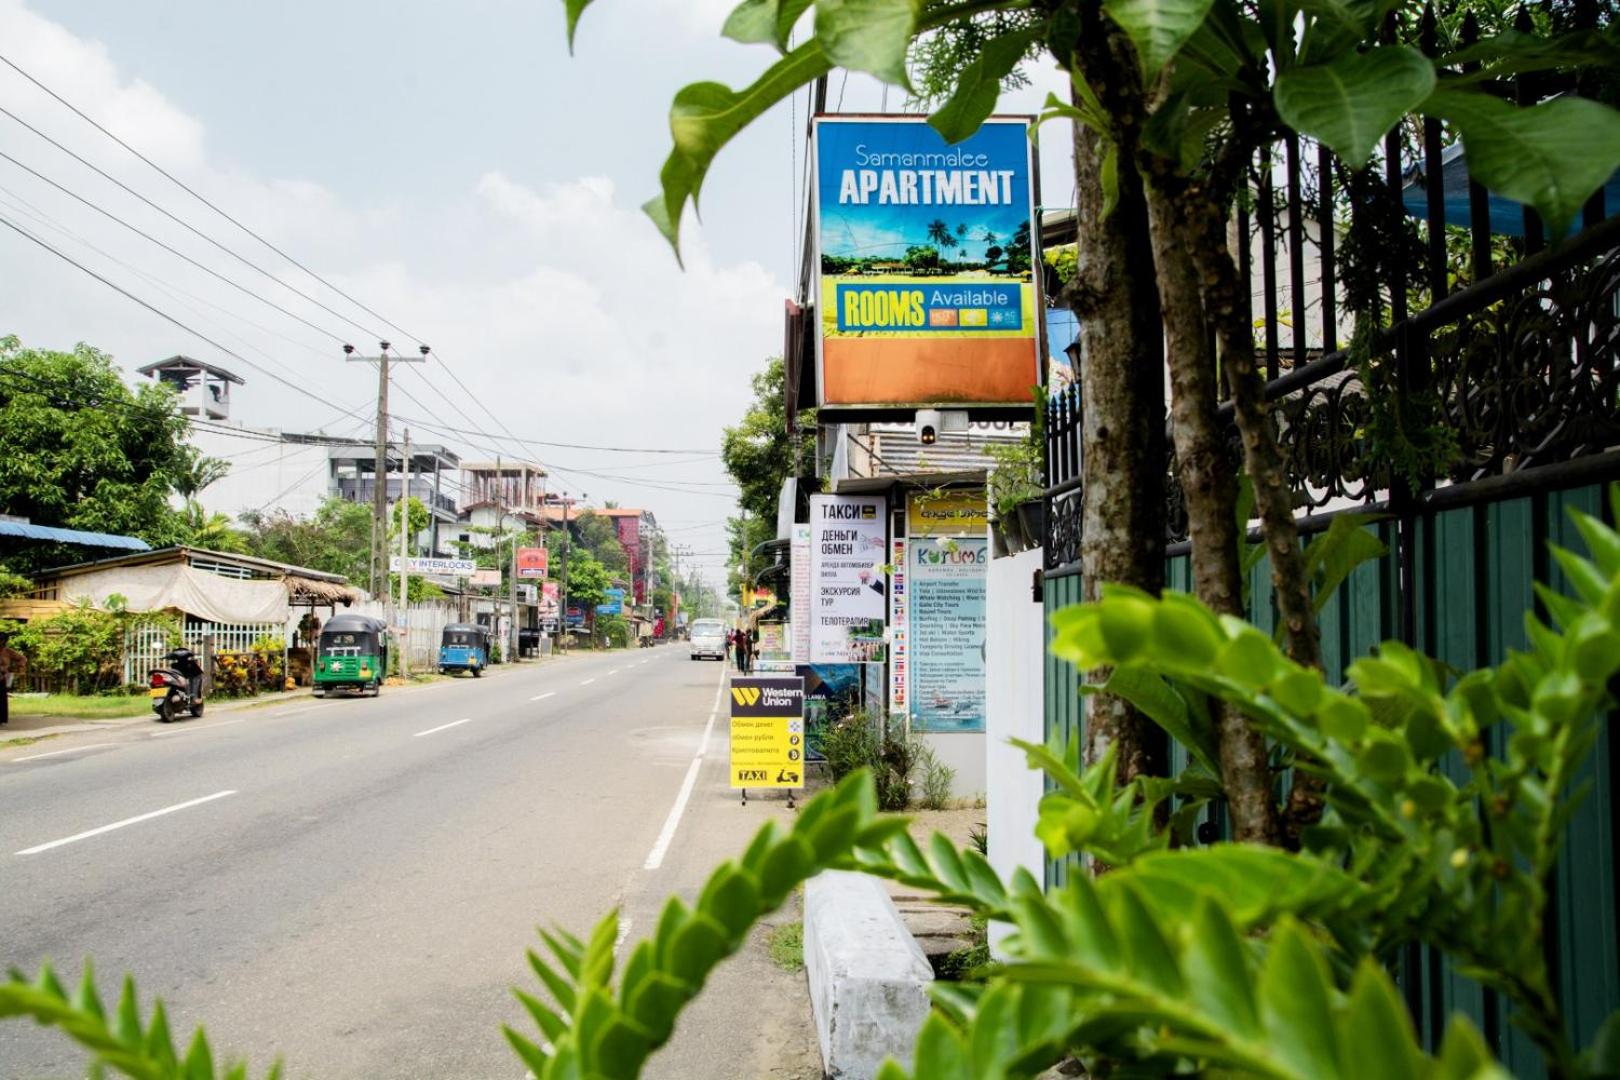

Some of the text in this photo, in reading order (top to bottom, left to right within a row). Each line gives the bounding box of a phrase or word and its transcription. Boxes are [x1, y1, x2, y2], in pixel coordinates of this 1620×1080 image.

[855, 145, 988, 167] Samanmalee
[839, 169, 1015, 205] APARTMENT
[844, 290, 925, 326] ROOMS
[930, 289, 1008, 305] Available
[821, 504, 861, 519] ТАКСИ
[821, 530, 858, 542] ДЕНЬГИ
[821, 543, 853, 555] ОБМЕН
[419, 559, 473, 570] INTERLOCKS
[820, 587, 861, 596] ЭКСКУРСИЯ
[820, 598, 834, 607] ТУР
[762, 687, 803, 697] Western
[762, 697, 792, 706] Union
[739, 770, 768, 781] TAXI
